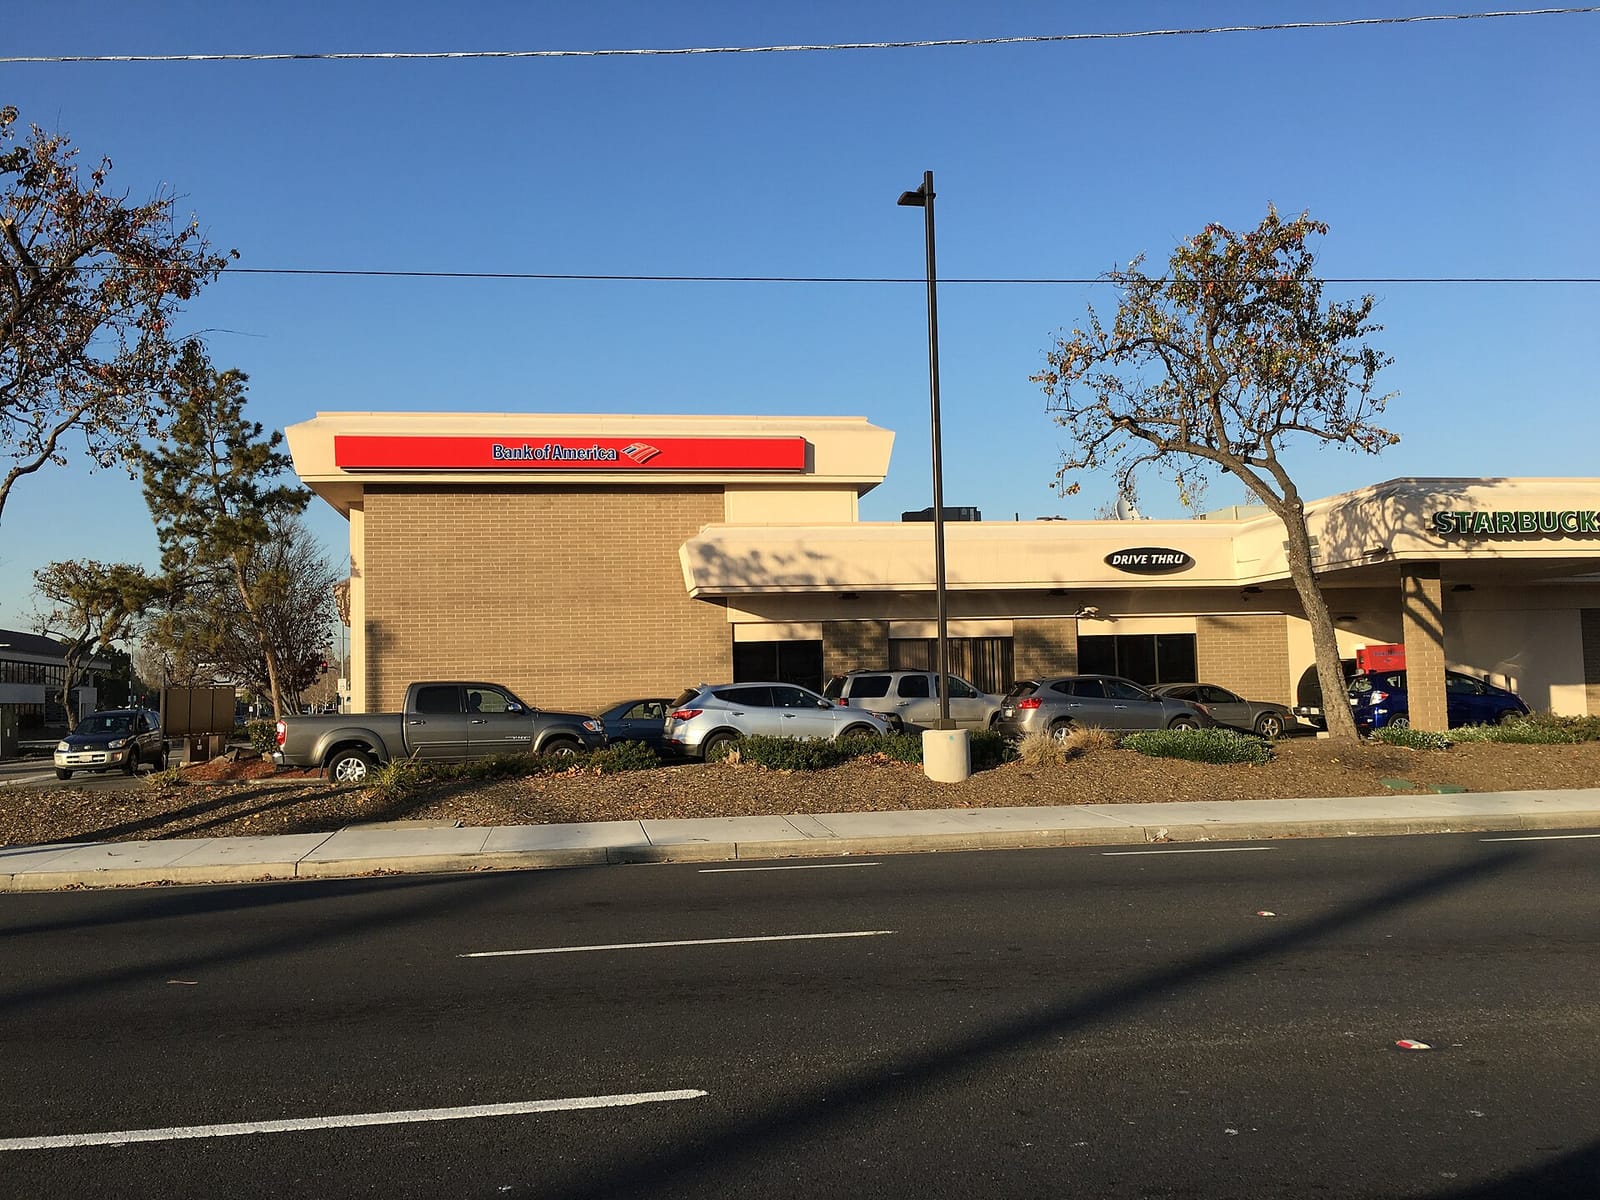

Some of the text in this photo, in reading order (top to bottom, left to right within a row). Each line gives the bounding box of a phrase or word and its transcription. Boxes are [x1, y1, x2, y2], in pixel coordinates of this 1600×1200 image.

[492, 444, 616, 460] Bank of America
[1436, 510, 1600, 533] STARBUCK
[1112, 554, 1184, 565] DRIVE THRU
